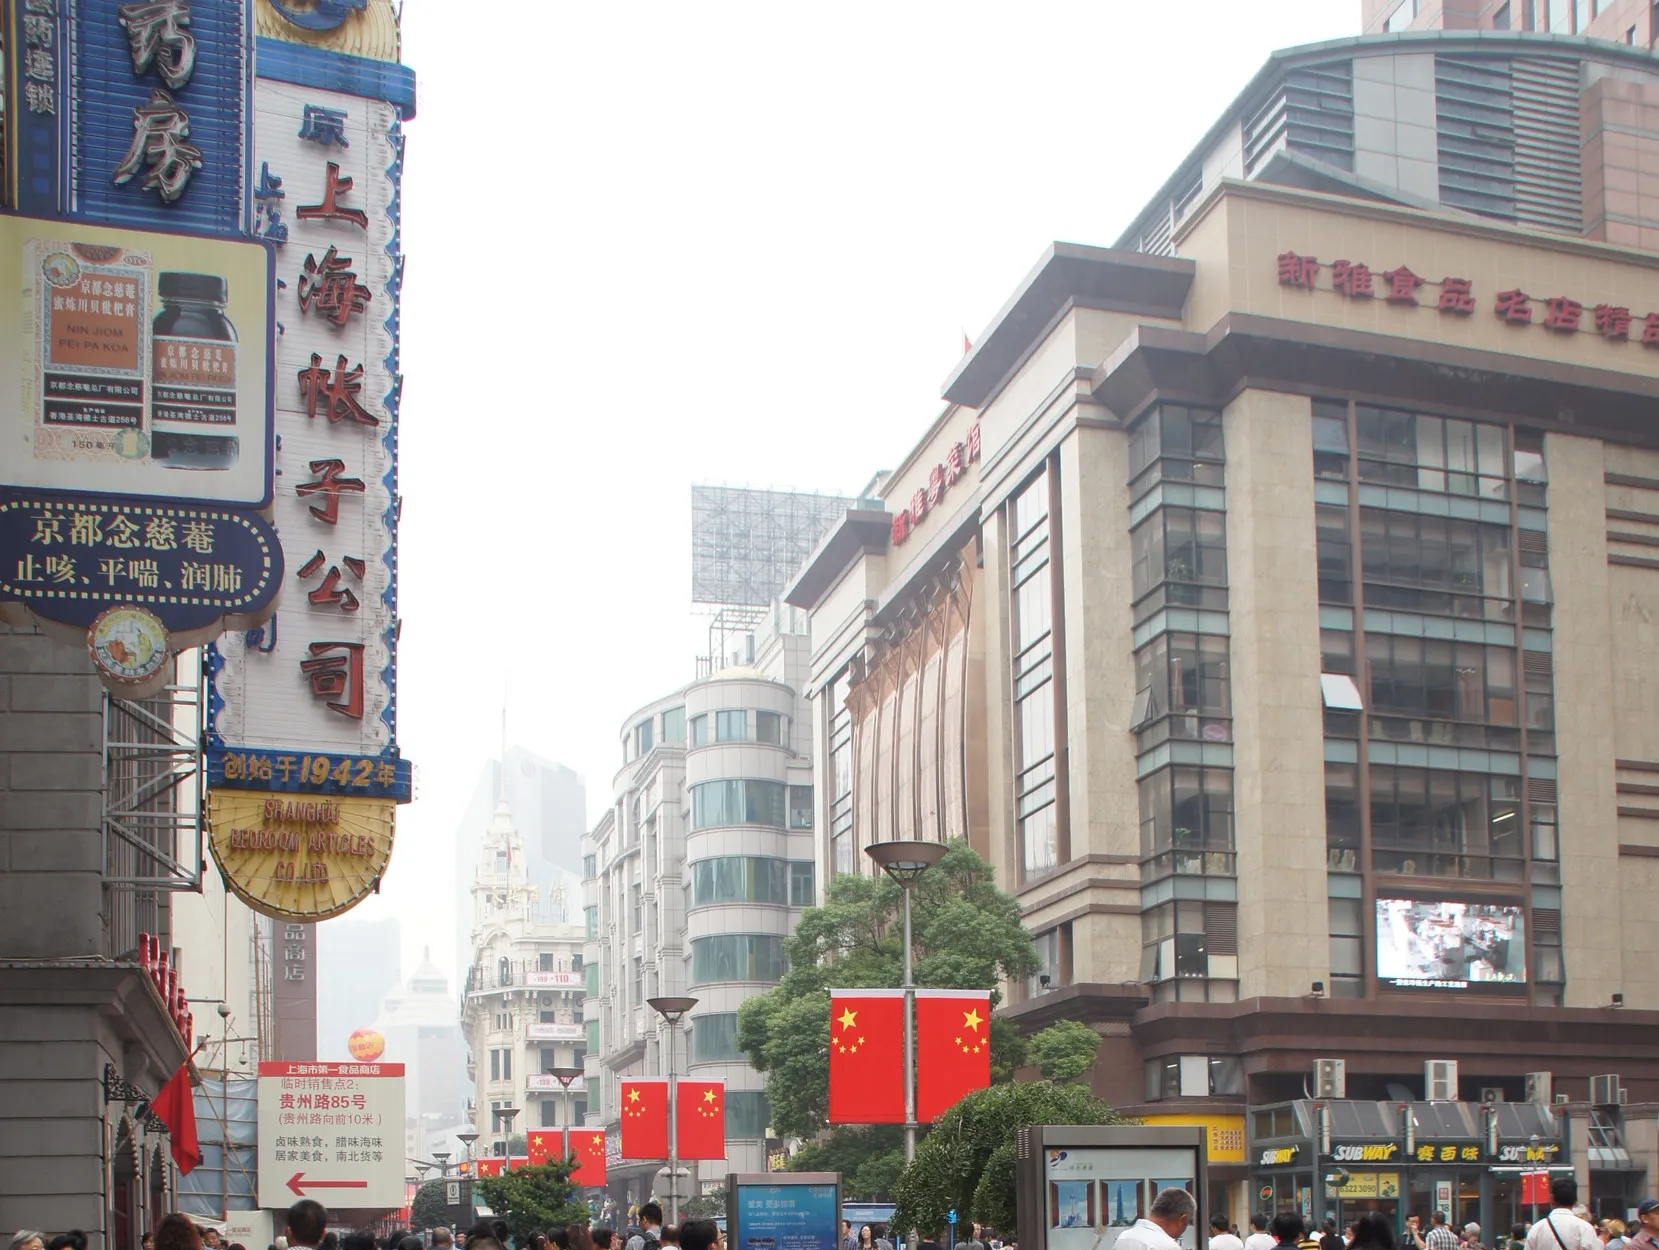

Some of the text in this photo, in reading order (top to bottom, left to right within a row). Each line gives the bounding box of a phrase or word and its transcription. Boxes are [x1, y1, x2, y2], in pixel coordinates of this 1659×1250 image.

[123, 255, 147, 267] OTC
[1277, 250, 1476, 318] 新雅食品
[66, 324, 123, 338] NIN JIOM
[84, 341, 99, 351] PA
[103, 343, 129, 353] KOA
[296, 160, 379, 720] 上海帐子公司
[14, 554, 243, 594] 止咳、平喘、润肺
[223, 752, 396, 788] 创始于1942年
[264, 799, 340, 824] SHANGHAI
[231, 829, 376, 857] BEDROOM ARTICLES
[286, 1065, 380, 1075] 上海市第一食品商店
[279, 1093, 367, 1110] 贵州路85号
[1260, 1146, 1297, 1165] SUBWAY
[1334, 1144, 1397, 1161] SUBWAY
[1417, 1145, 1479, 1162] 赛百味
